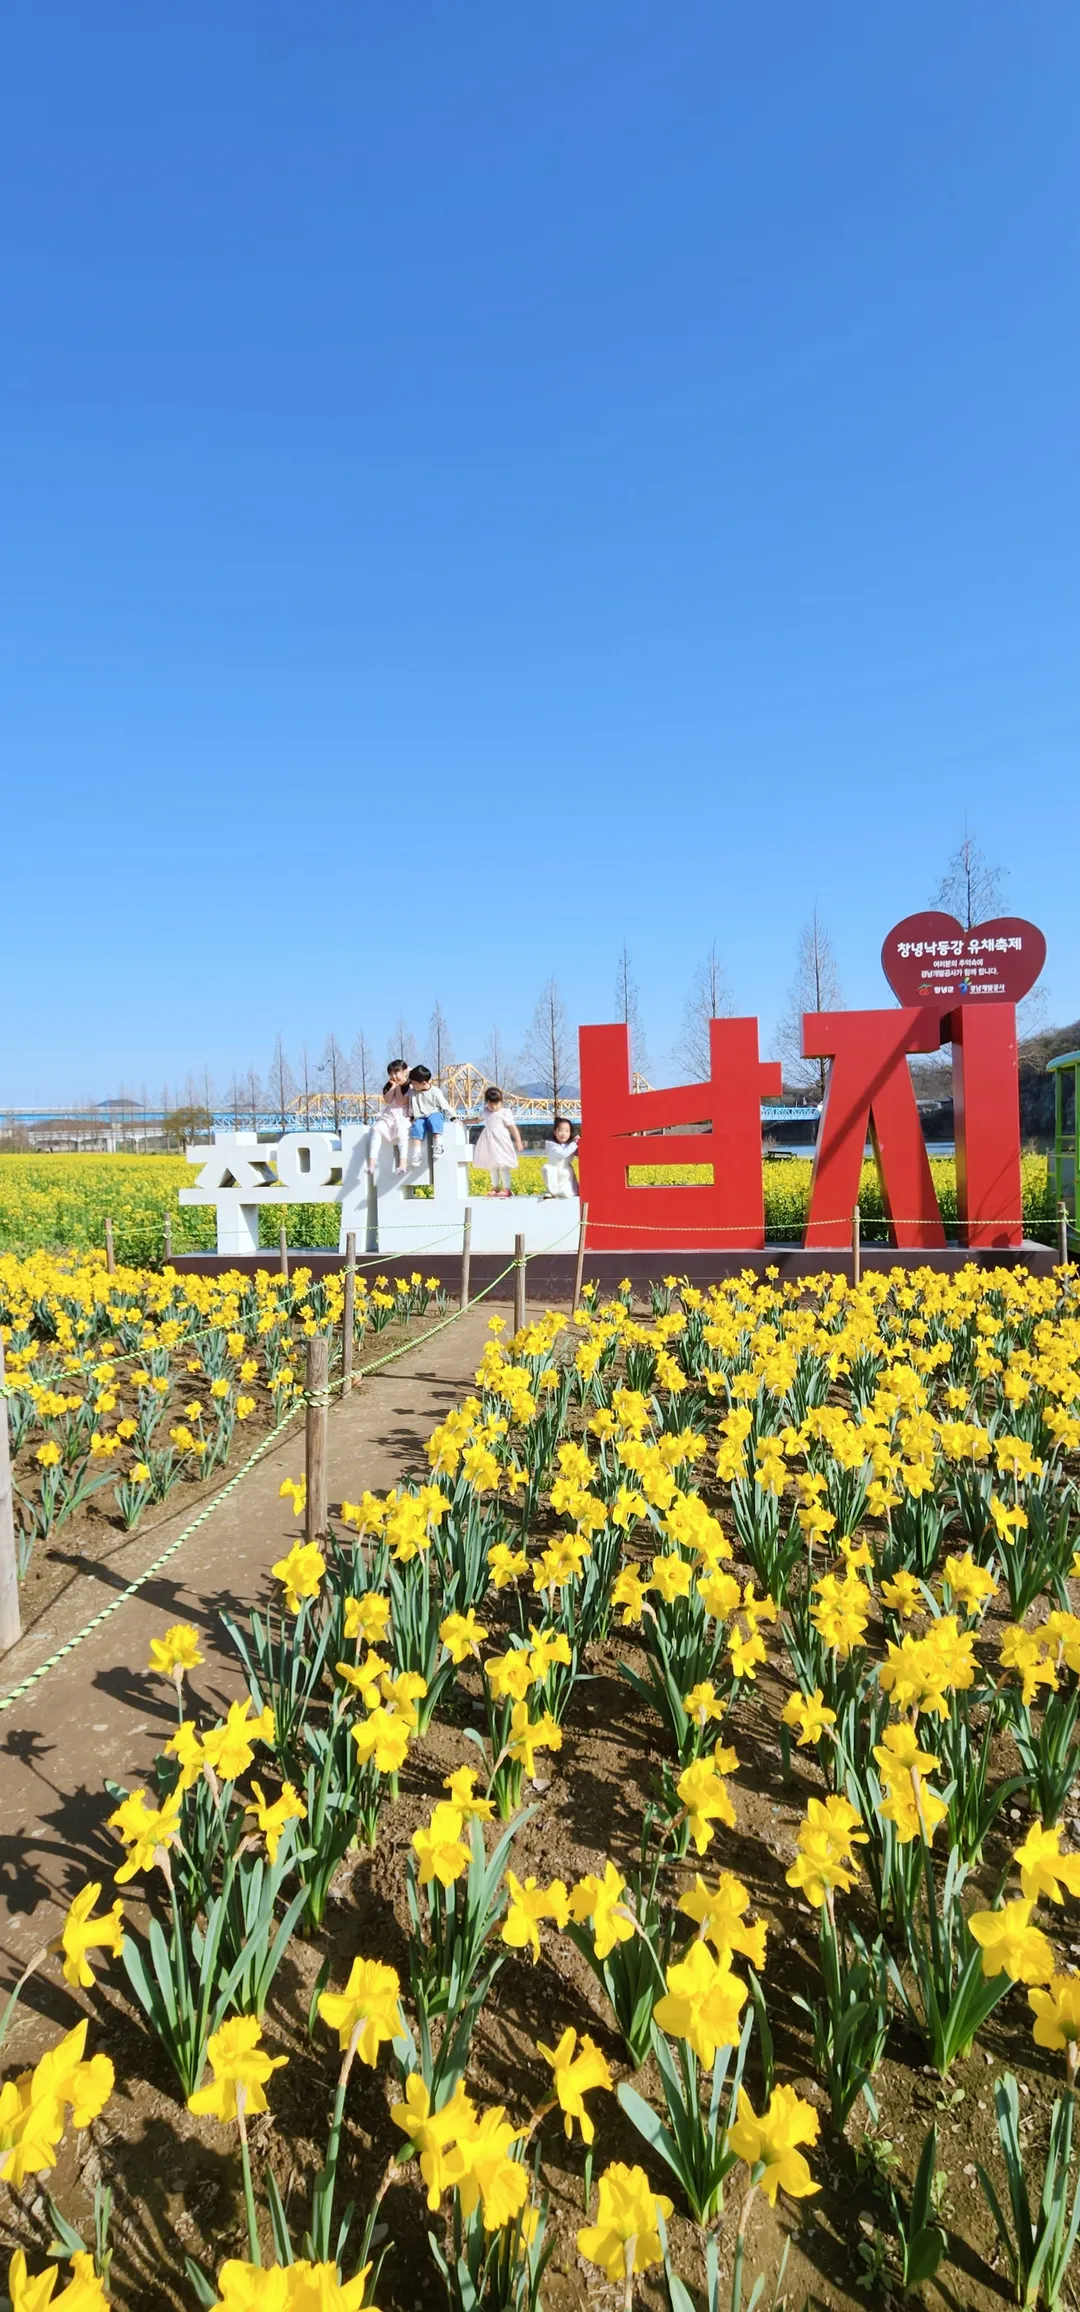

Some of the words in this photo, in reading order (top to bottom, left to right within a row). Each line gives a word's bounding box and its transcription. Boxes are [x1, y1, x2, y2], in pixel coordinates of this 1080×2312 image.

[897, 940, 964, 958] 창녕낙동강
[967, 937, 1022, 954] 유채축제
[933, 959, 958, 968] 여러분의
[934, 985, 954, 994] 창녕군
[579, 1002, 1023, 1251] 남지
